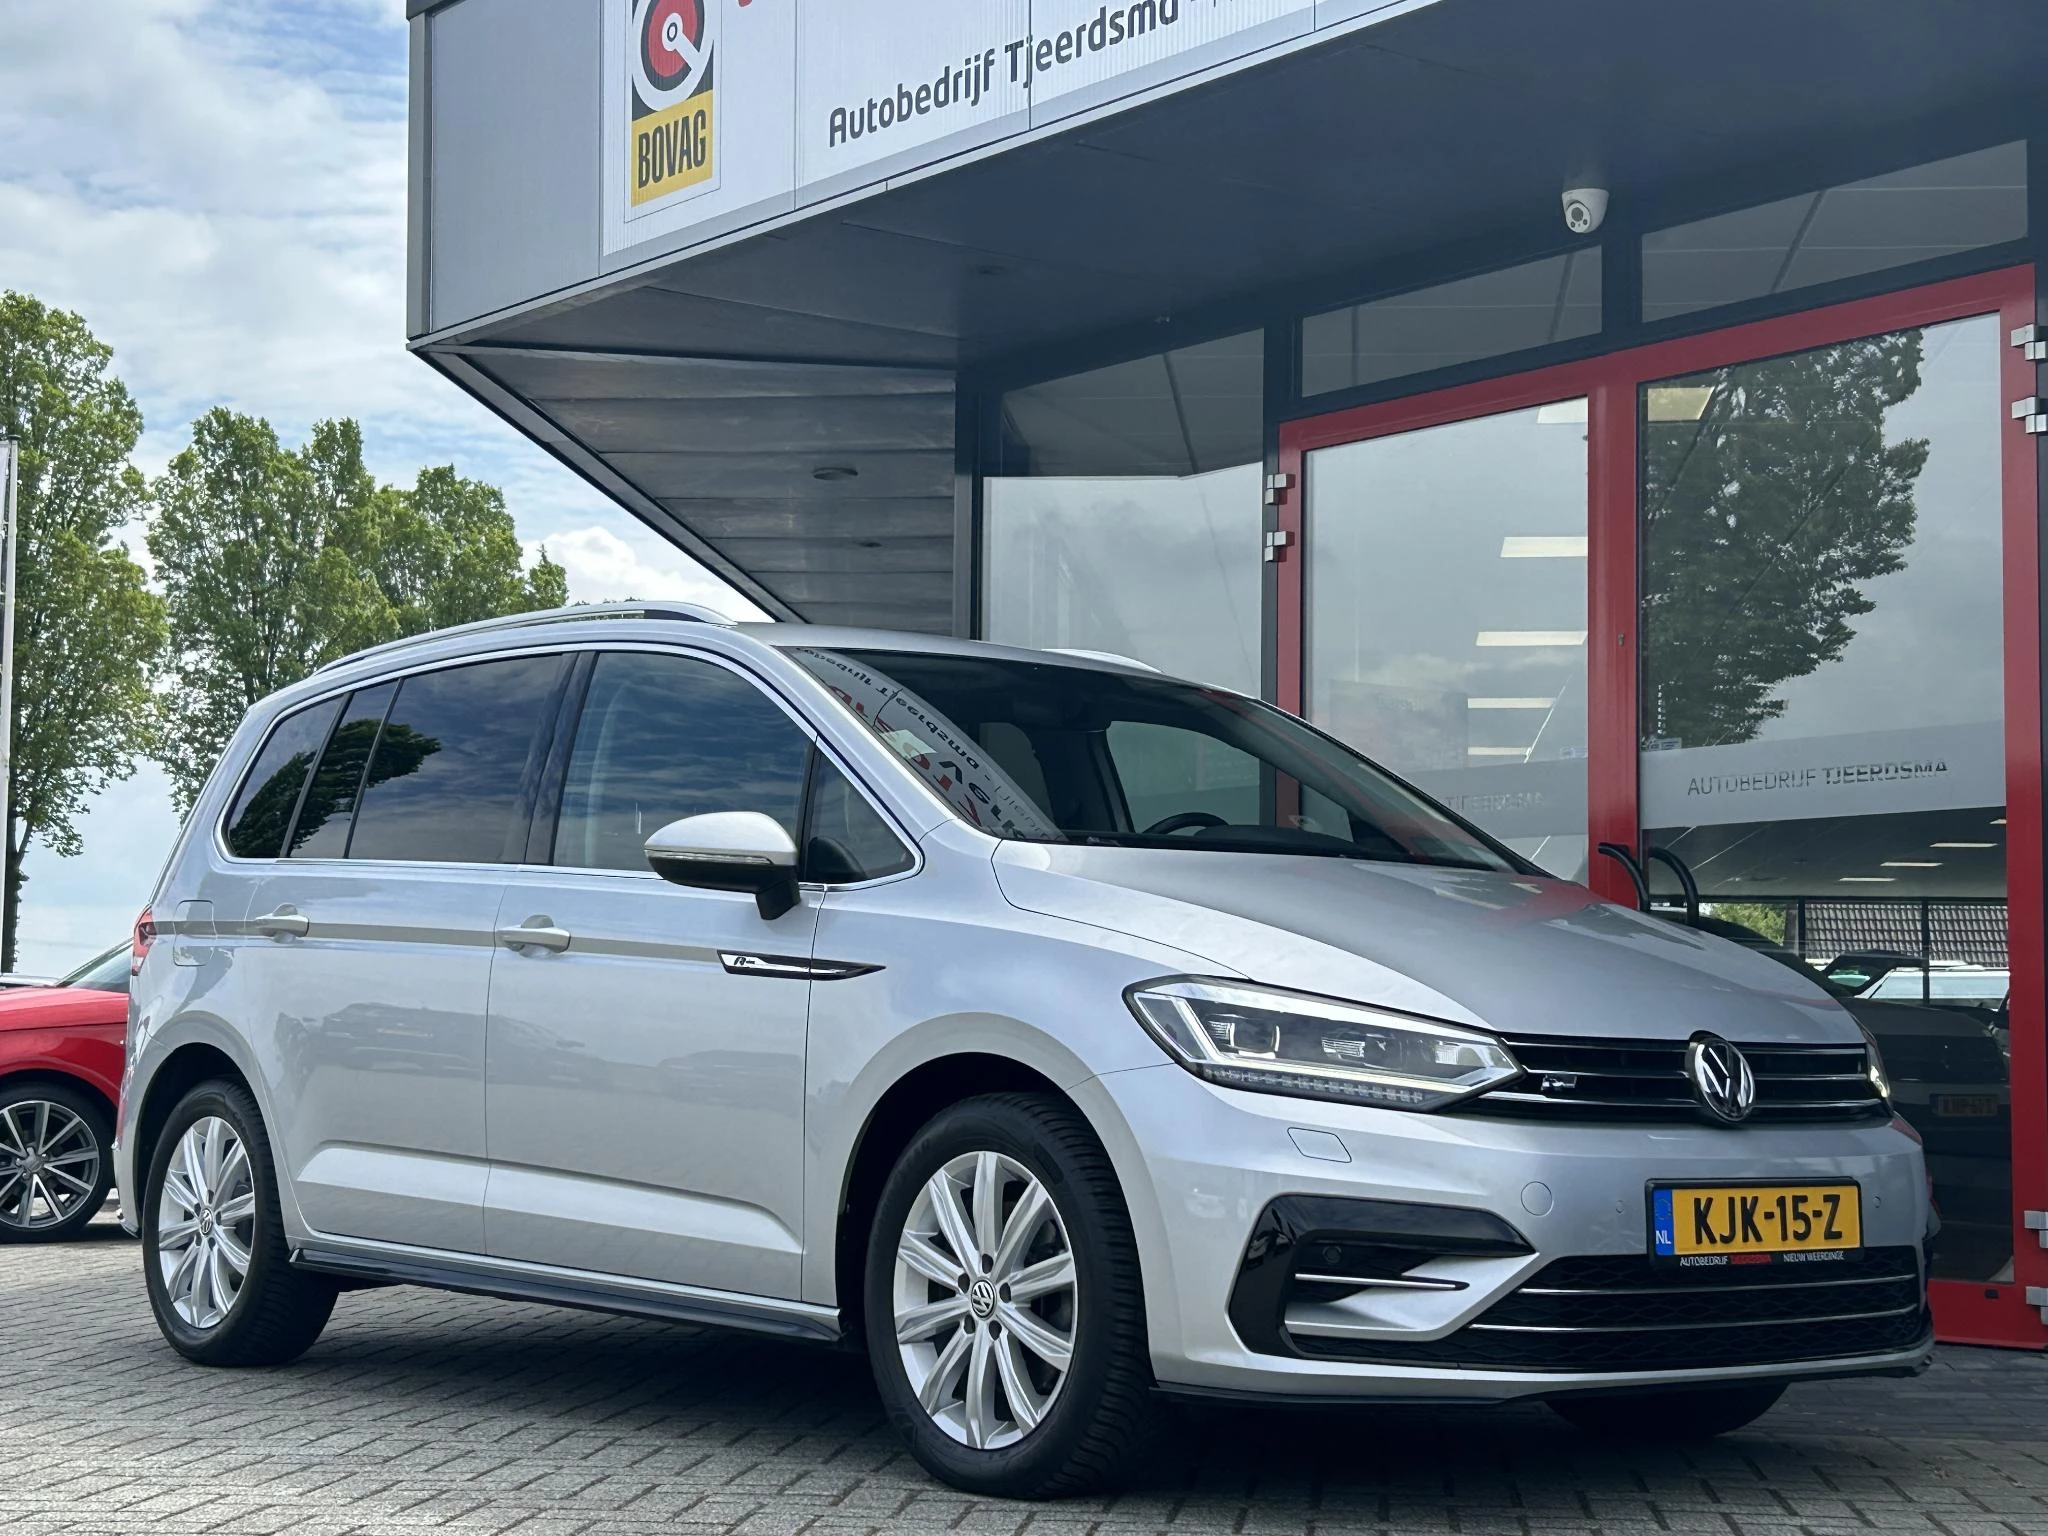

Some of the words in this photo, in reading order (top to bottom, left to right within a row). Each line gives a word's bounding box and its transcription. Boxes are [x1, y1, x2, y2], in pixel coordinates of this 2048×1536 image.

[829, 48, 996, 148] Autobedrijf
[1004, 0, 1179, 88] Tjeerdsma
[637, 108, 707, 189] BOVAG
[1687, 768, 1817, 796] AUTOBEDRIJF
[1821, 758, 1948, 786] TJEERDSMA
[1655, 1230, 1672, 1245] NL
[1693, 1193, 1843, 1245] KJK-15-Z
